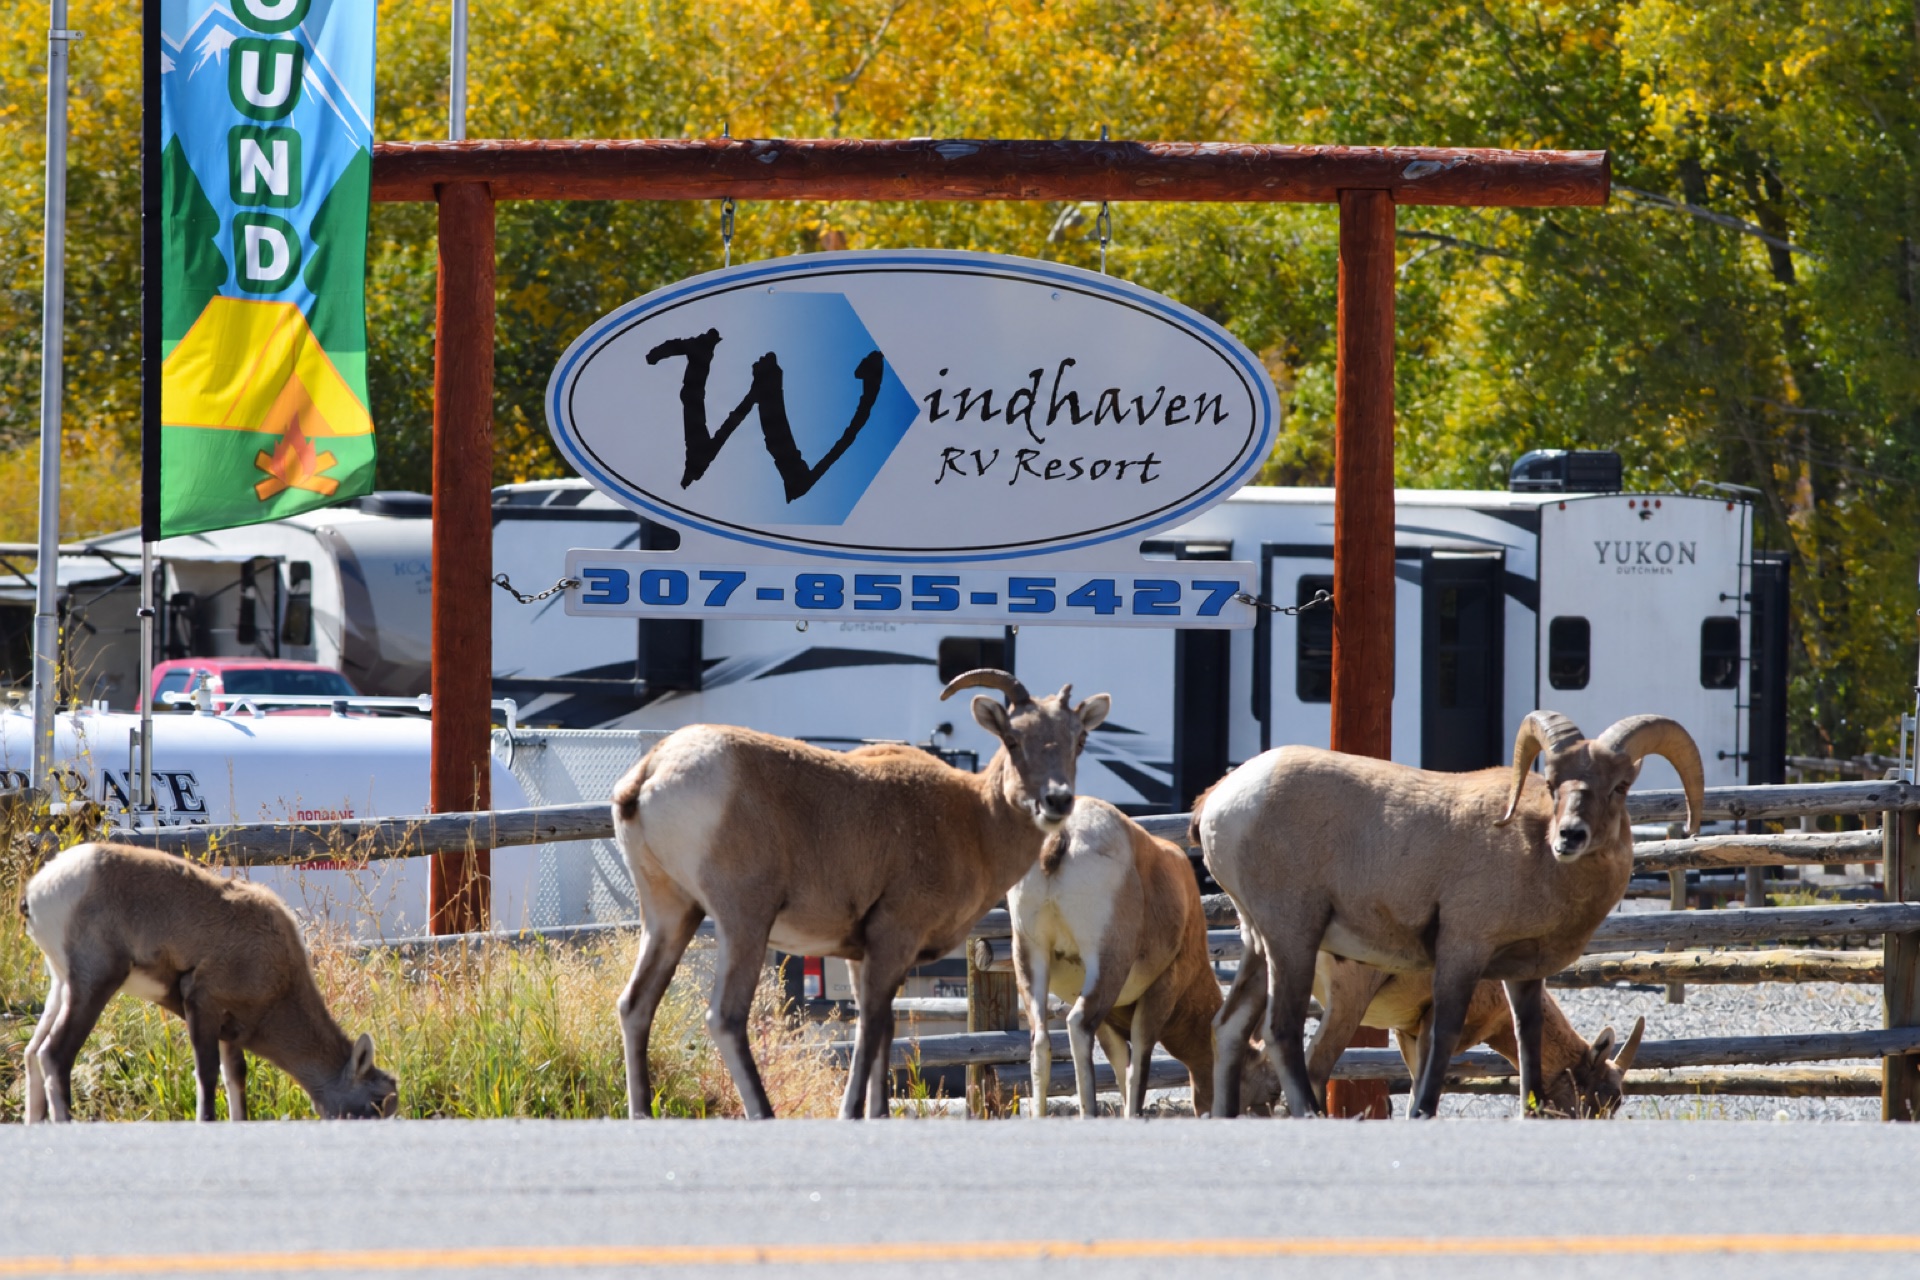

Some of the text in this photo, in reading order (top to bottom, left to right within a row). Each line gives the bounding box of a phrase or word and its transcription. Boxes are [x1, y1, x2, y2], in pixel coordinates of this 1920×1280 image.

[646, 327, 1229, 504] Windhaven
[936, 444, 1162, 486] RV Resort
[1594, 541, 1697, 565] YUKON
[581, 566, 1241, 616] 307-855-5427
